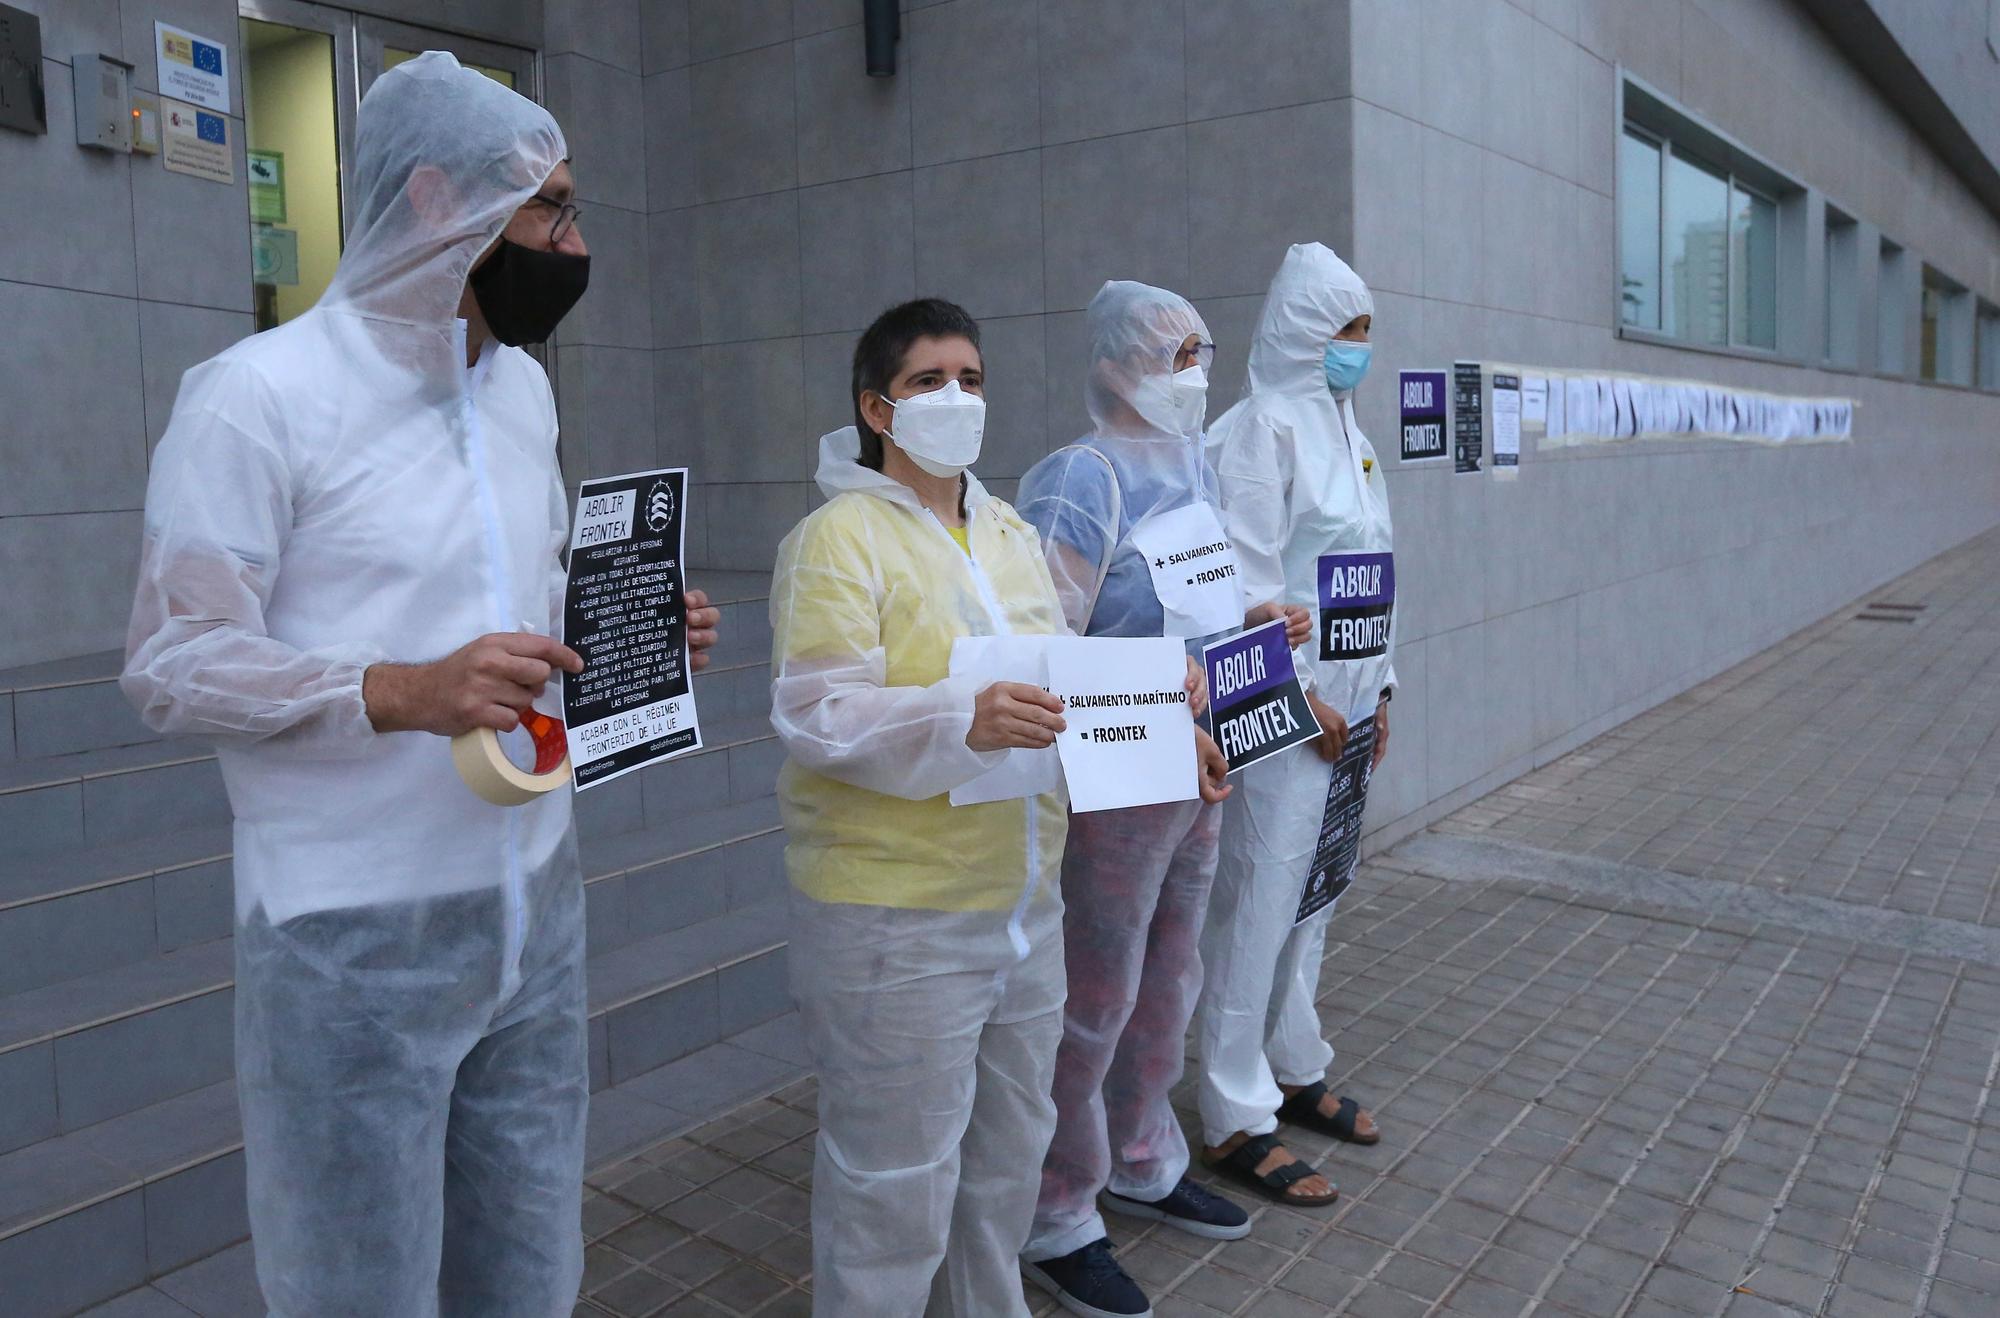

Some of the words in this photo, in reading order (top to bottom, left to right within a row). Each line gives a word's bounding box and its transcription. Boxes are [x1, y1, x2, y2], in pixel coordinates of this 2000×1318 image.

[1404, 382, 1433, 408] ABOLIR
[1404, 424, 1441, 452] FRONTEX
[584, 495, 624, 518] ABOLIR
[580, 520, 627, 544] FRONTEX
[591, 546, 622, 559] REGULARIZAR
[630, 542, 638, 552] LAS
[640, 539, 662, 550] PERSONAS
[1168, 542, 1224, 565] SALVAMENTO
[577, 575, 596, 585] ACABAR
[597, 573, 606, 581] CON
[609, 569, 623, 578] TODAS
[625, 567, 634, 575] LAS
[636, 560, 675, 572] DEPORTACIONES
[586, 586, 602, 595] PONER
[604, 583, 613, 592] FIN
[621, 579, 630, 588] LAS
[632, 572, 667, 586] DETENCIONES
[1196, 564, 1236, 585] FRONTE
[1330, 564, 1382, 599] ABOLIR
[580, 598, 599, 608] ACABAR
[600, 596, 610, 604] CON
[621, 584, 665, 599] MILITARIZACIÓN
[667, 582, 674, 590] DE
[584, 611, 594, 620] LAS
[596, 604, 623, 617] FRONTERAS
[626, 602, 632, 610] (Y
[635, 600, 642, 608] EL
[644, 595, 671, 606] COMPLEJO
[581, 634, 600, 645] ACABAR
[602, 631, 611, 640] CON
[613, 629, 620, 637] LA
[622, 621, 655, 634] VIGILANCIA
[657, 618, 664, 626] DE
[666, 616, 677, 625] LAS
[598, 615, 628, 629] INDUSTRIAL
[630, 609, 657, 621] MILITAR)
[590, 642, 614, 655] PERSONAS
[616, 638, 626, 648] QUE
[628, 636, 635, 644] SE
[638, 630, 668, 642] DESPLAZAN
[592, 652, 619, 666] POTENCIAR
[621, 649, 628, 657] LA
[631, 641, 667, 656] SOLIDARIDAD
[578, 670, 598, 682] ACABAR
[600, 667, 610, 676] CON
[611, 664, 621, 673] LAS
[623, 655, 653, 669] POLÍTICAS
[656, 652, 663, 660] DE
[664, 651, 671, 659] LA
[673, 649, 679, 657] UE
[581, 684, 592, 693] QUE
[594, 676, 616, 690] OBLIGAN
[624, 672, 631, 681] LA
[633, 667, 650, 678] GENTE
[659, 660, 677, 672] MIGRAR
[1216, 644, 1267, 700] ABOLIR
[575, 692, 603, 707] LIBERTAD
[604, 690, 612, 699] DE
[613, 679, 650, 696] CIRCULACIÓN
[651, 676, 664, 684] PARA
[666, 670, 680, 680] TODAS
[610, 698, 621, 708] LAS
[624, 690, 650, 704] PERSONAS
[1069, 694, 1131, 708] SALVAMENTO
[1133, 690, 1186, 705] MARÍTIMO
[580, 723, 610, 742] ACABAR
[613, 718, 628, 732] CON
[632, 713, 642, 725] EL
[646, 701, 680, 720] RÉGIMEN
[1093, 725, 1147, 743] FRONTEX
[1220, 695, 1301, 760] FRONTEX
[587, 731, 635, 757] FRONTERIZO
[639, 726, 649, 739] DE
[653, 723, 662, 735] LA
[666, 718, 677, 730] UE
